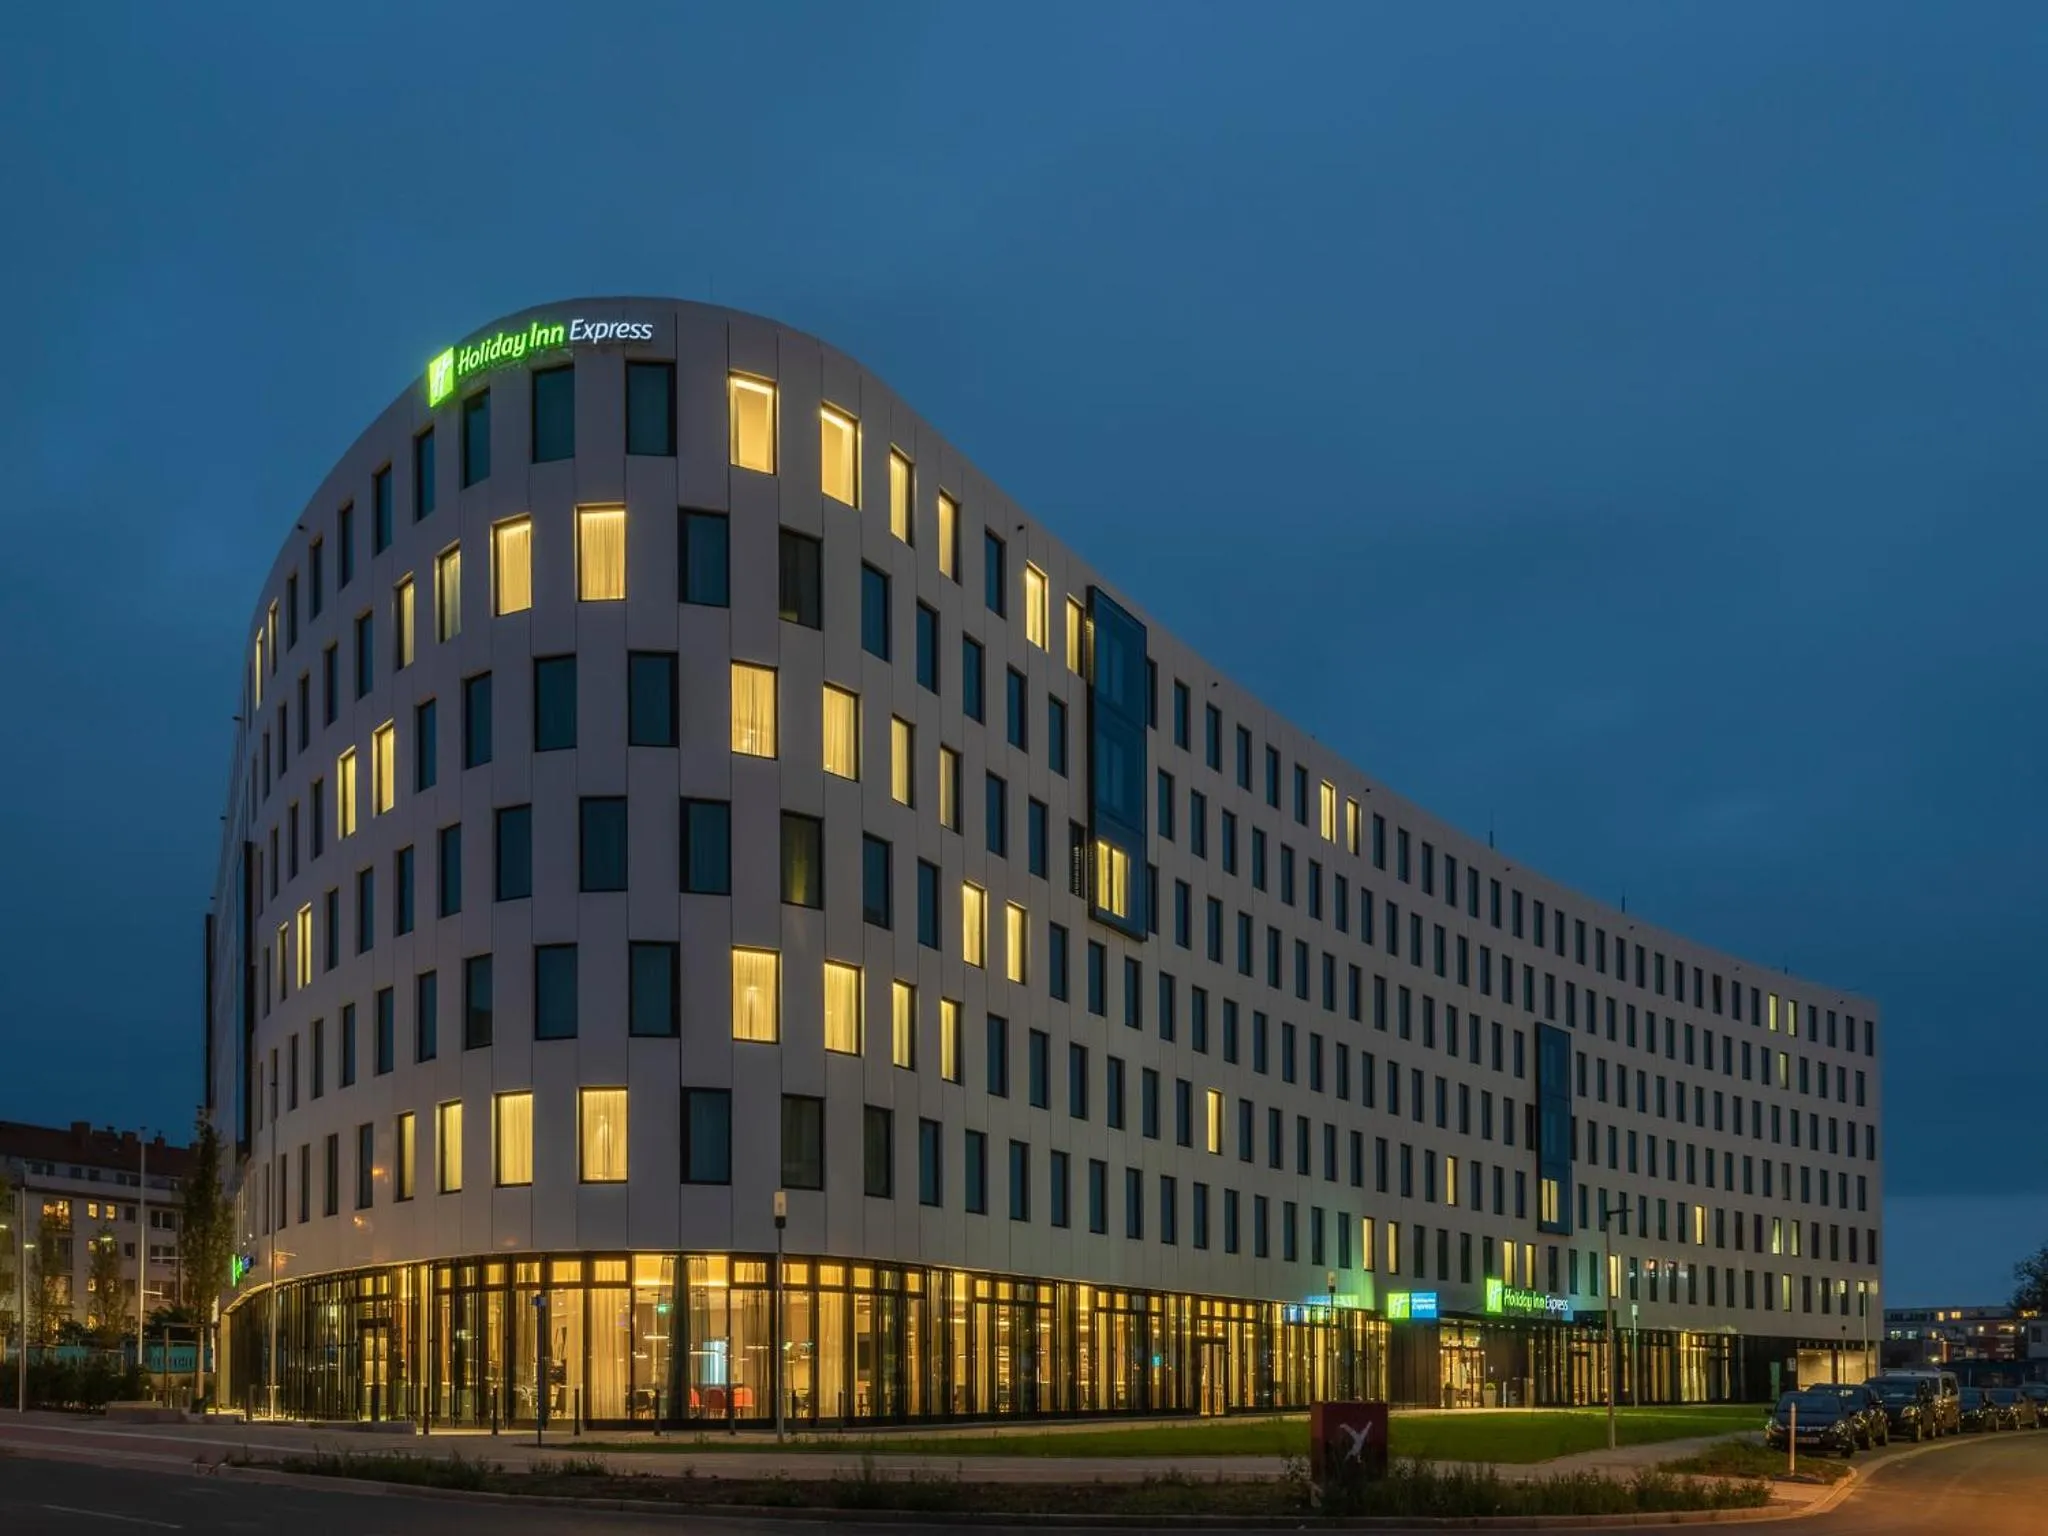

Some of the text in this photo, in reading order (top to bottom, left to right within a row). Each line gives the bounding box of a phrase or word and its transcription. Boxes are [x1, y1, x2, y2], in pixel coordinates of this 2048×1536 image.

[458, 331, 528, 375] Holiday
[529, 322, 565, 347] Inn
[569, 318, 653, 345] Express
[1504, 1288, 1533, 1312] Holiday
[1545, 1294, 1569, 1315] Express
